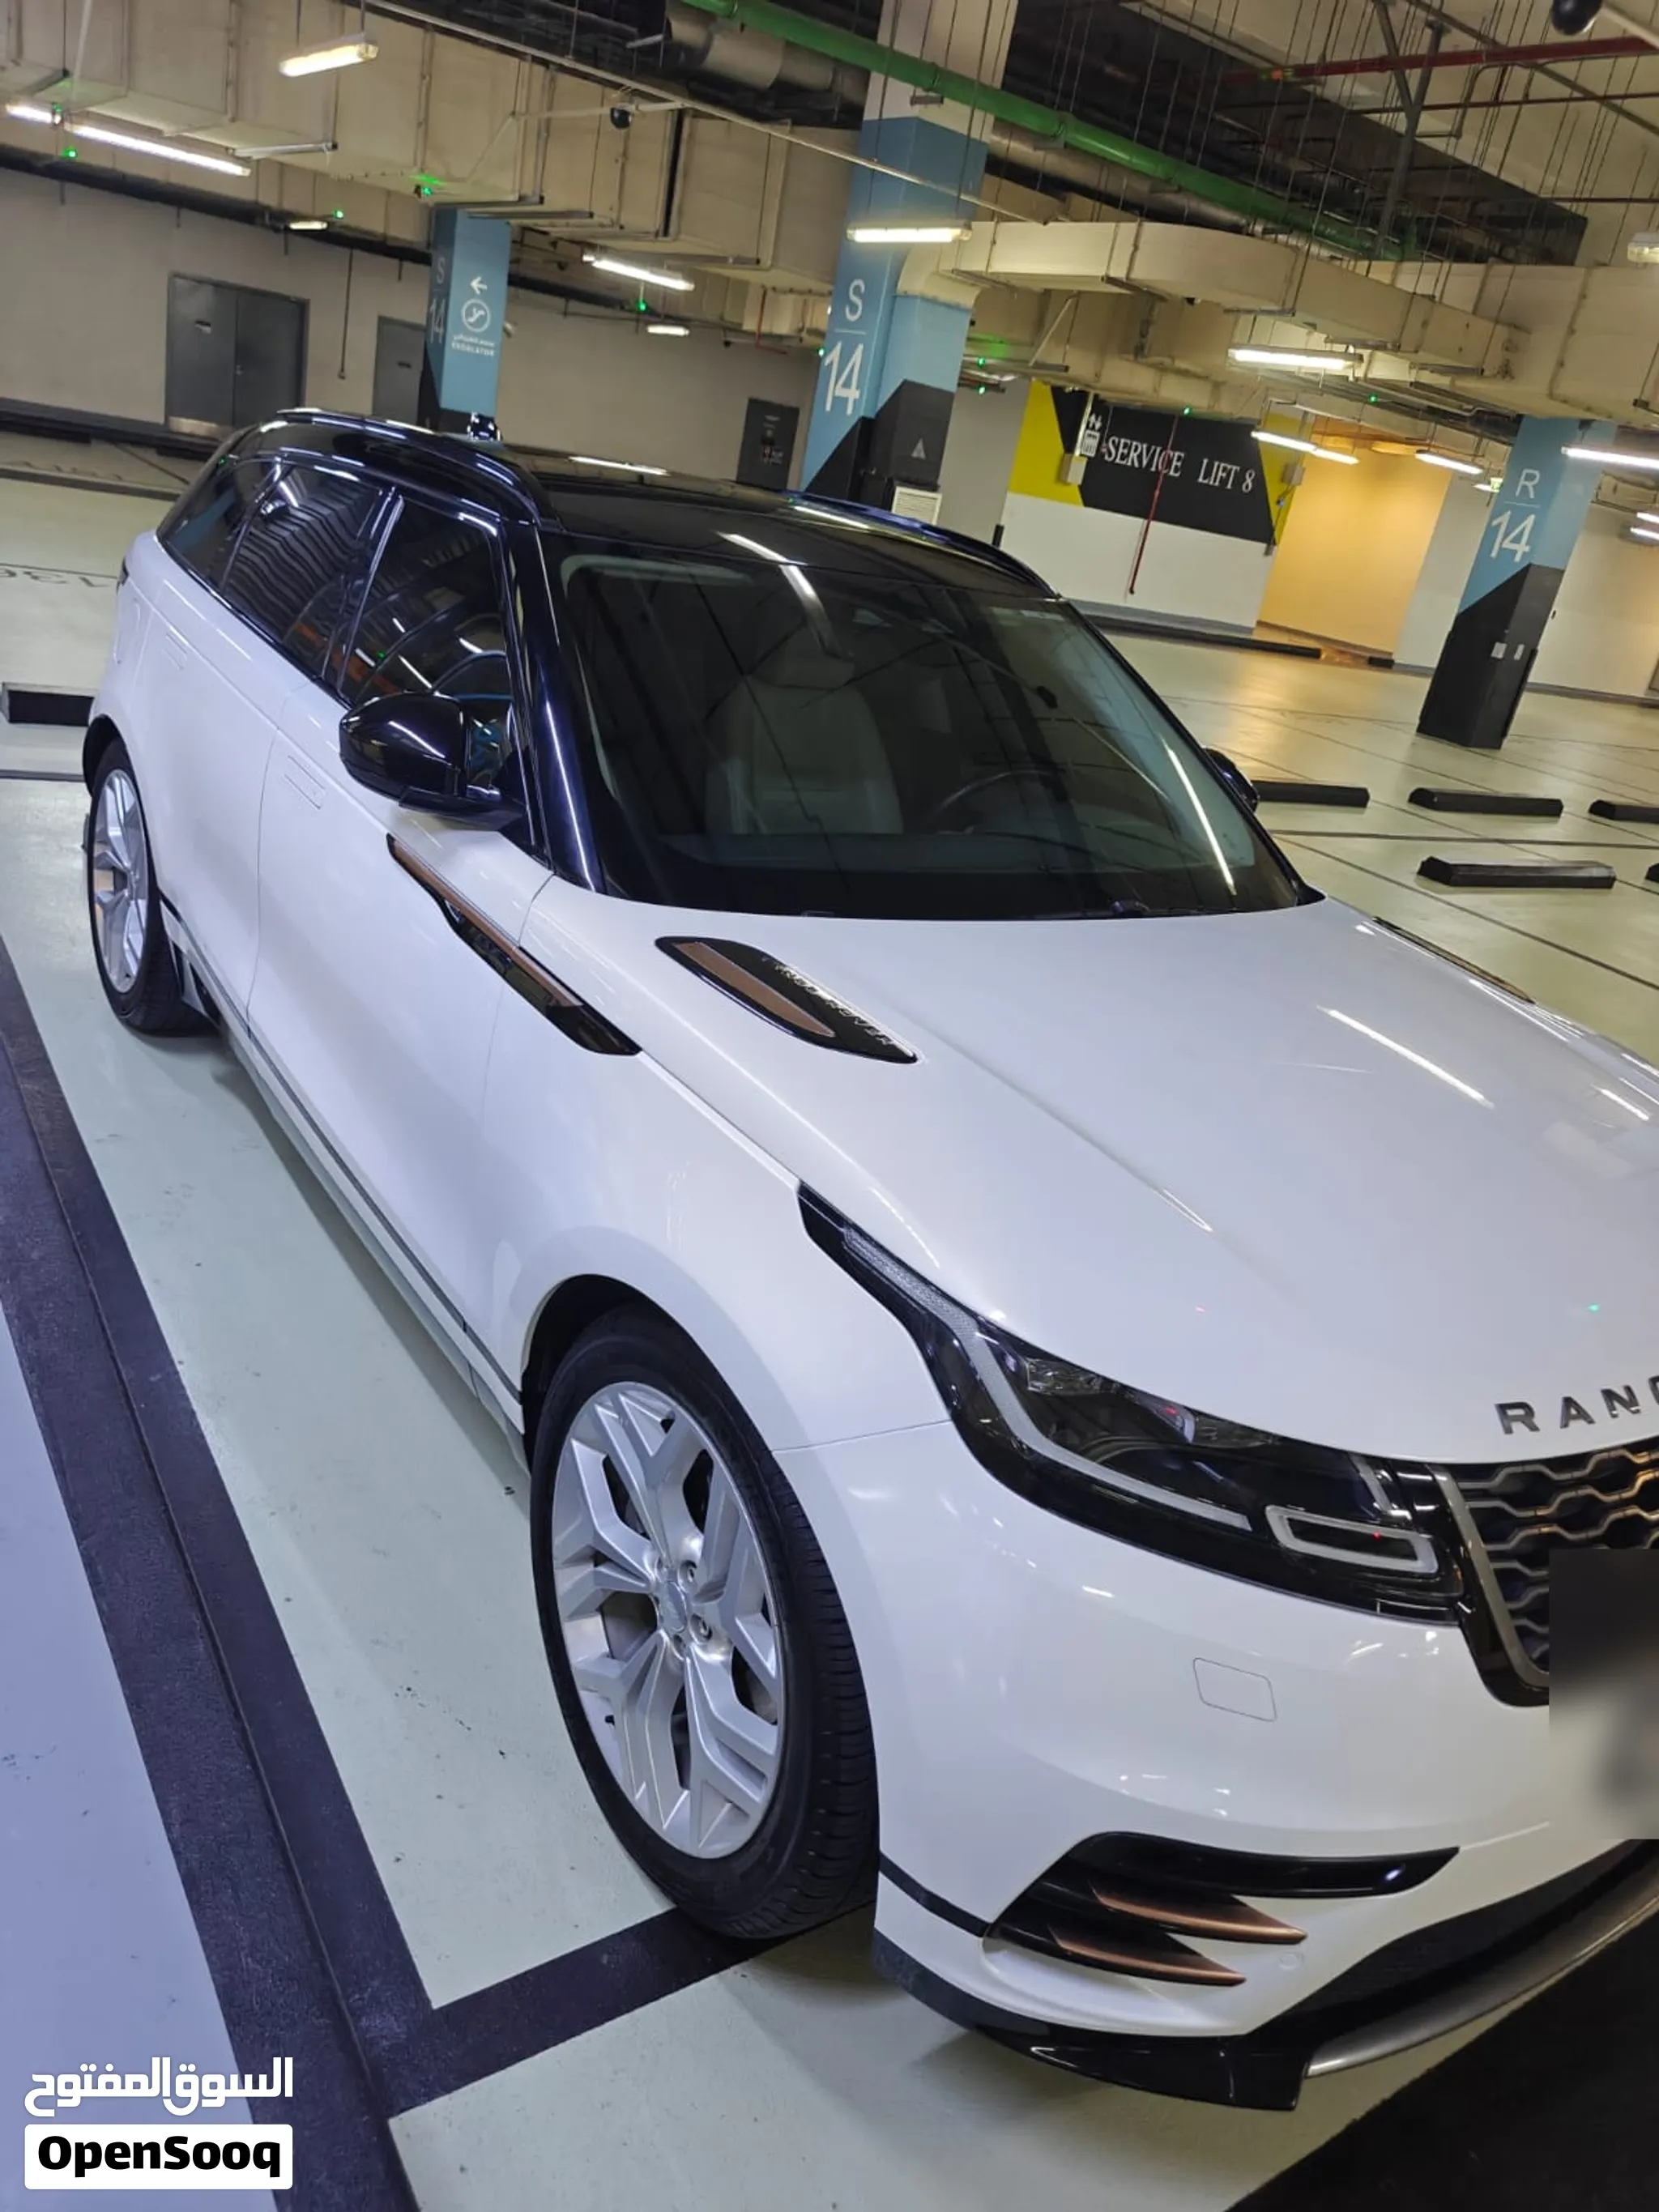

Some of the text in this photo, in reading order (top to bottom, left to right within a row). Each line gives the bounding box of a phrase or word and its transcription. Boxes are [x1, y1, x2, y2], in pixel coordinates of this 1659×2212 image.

[429, 297, 446, 344] 14
[845, 278, 866, 322] S
[824, 340, 864, 416] 14
[1104, 435, 1256, 493] SERVICE LIFT 8
[1515, 467, 1541, 499] R
[1489, 509, 1537, 563] 14
